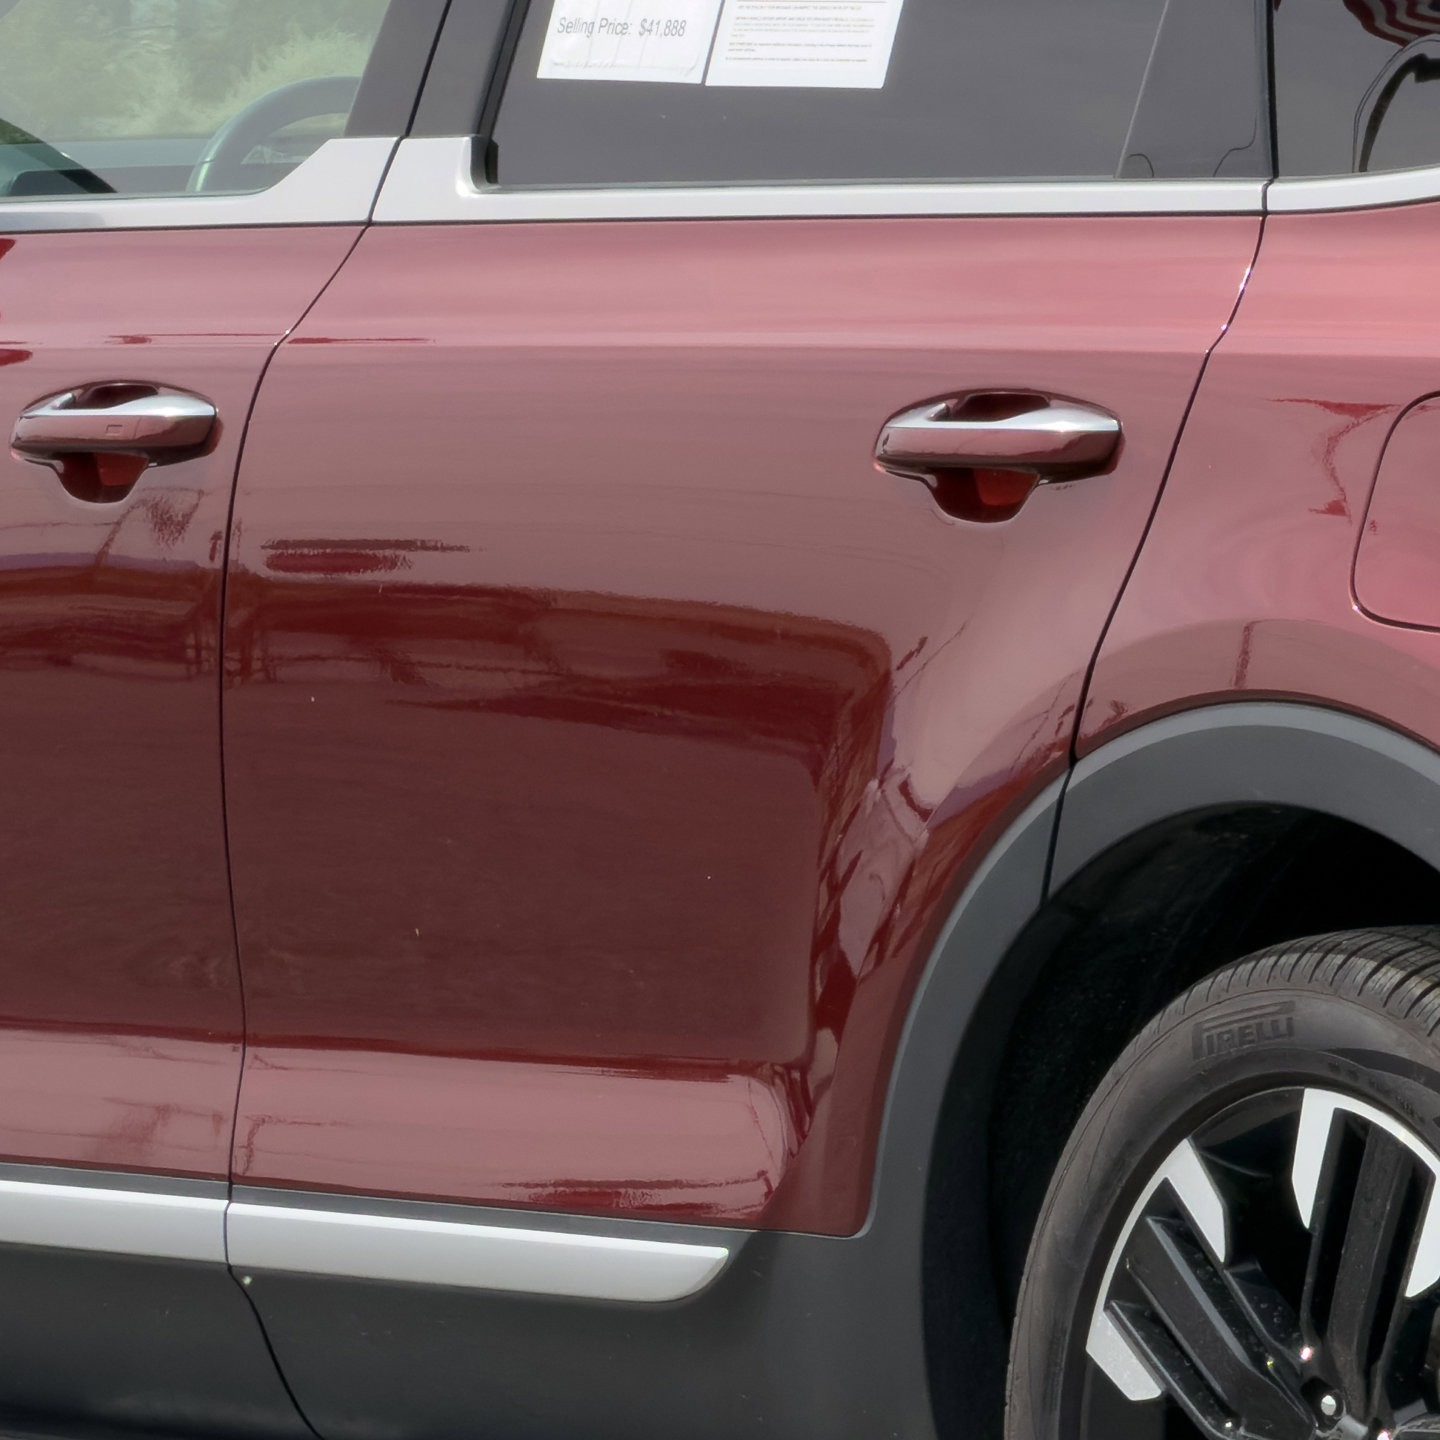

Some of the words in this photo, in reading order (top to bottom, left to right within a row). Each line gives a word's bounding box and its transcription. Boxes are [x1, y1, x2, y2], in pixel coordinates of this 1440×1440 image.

[557, 17, 595, 38] Selling
[597, 17, 633, 36] Price:
[638, 18, 687, 38] $41,888
[1192, 1001, 1296, 1061] PIRELLI
